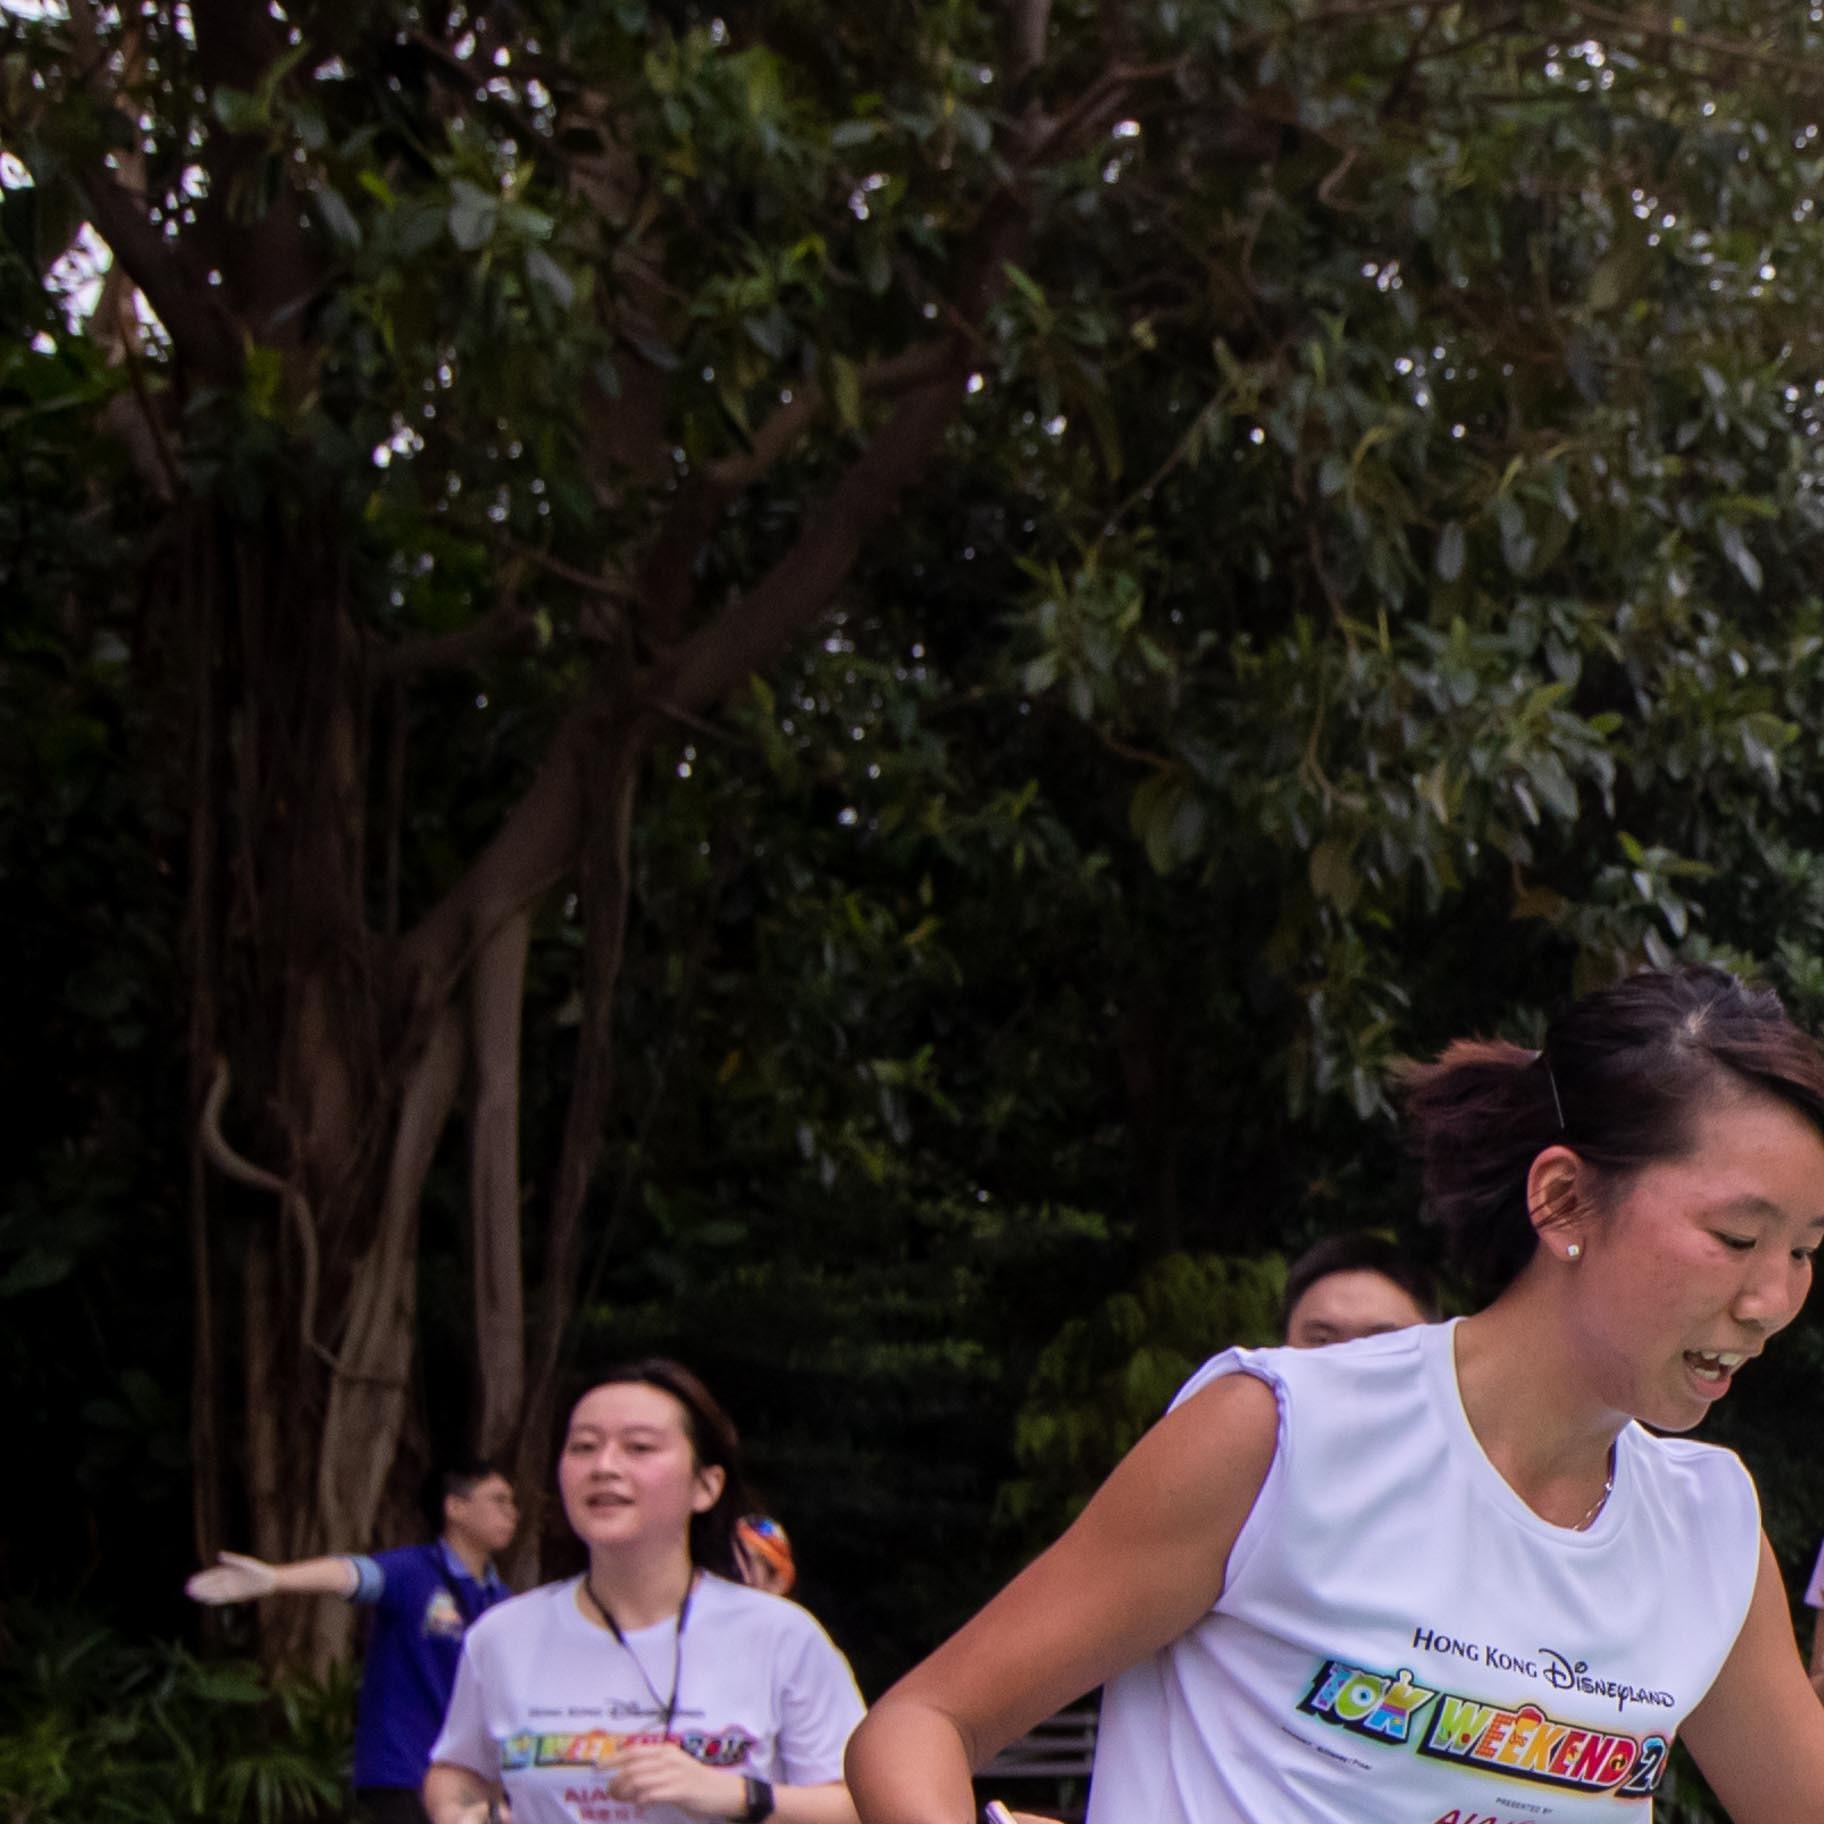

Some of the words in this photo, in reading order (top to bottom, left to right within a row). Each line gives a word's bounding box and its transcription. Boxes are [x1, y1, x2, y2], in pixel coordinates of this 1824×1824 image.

[1412, 1627, 1479, 1662] HONG
[1485, 1645, 1538, 1679] KONG
[1298, 1660, 1438, 1744] 10K
[1419, 1693, 1640, 1793] WEEKEND
